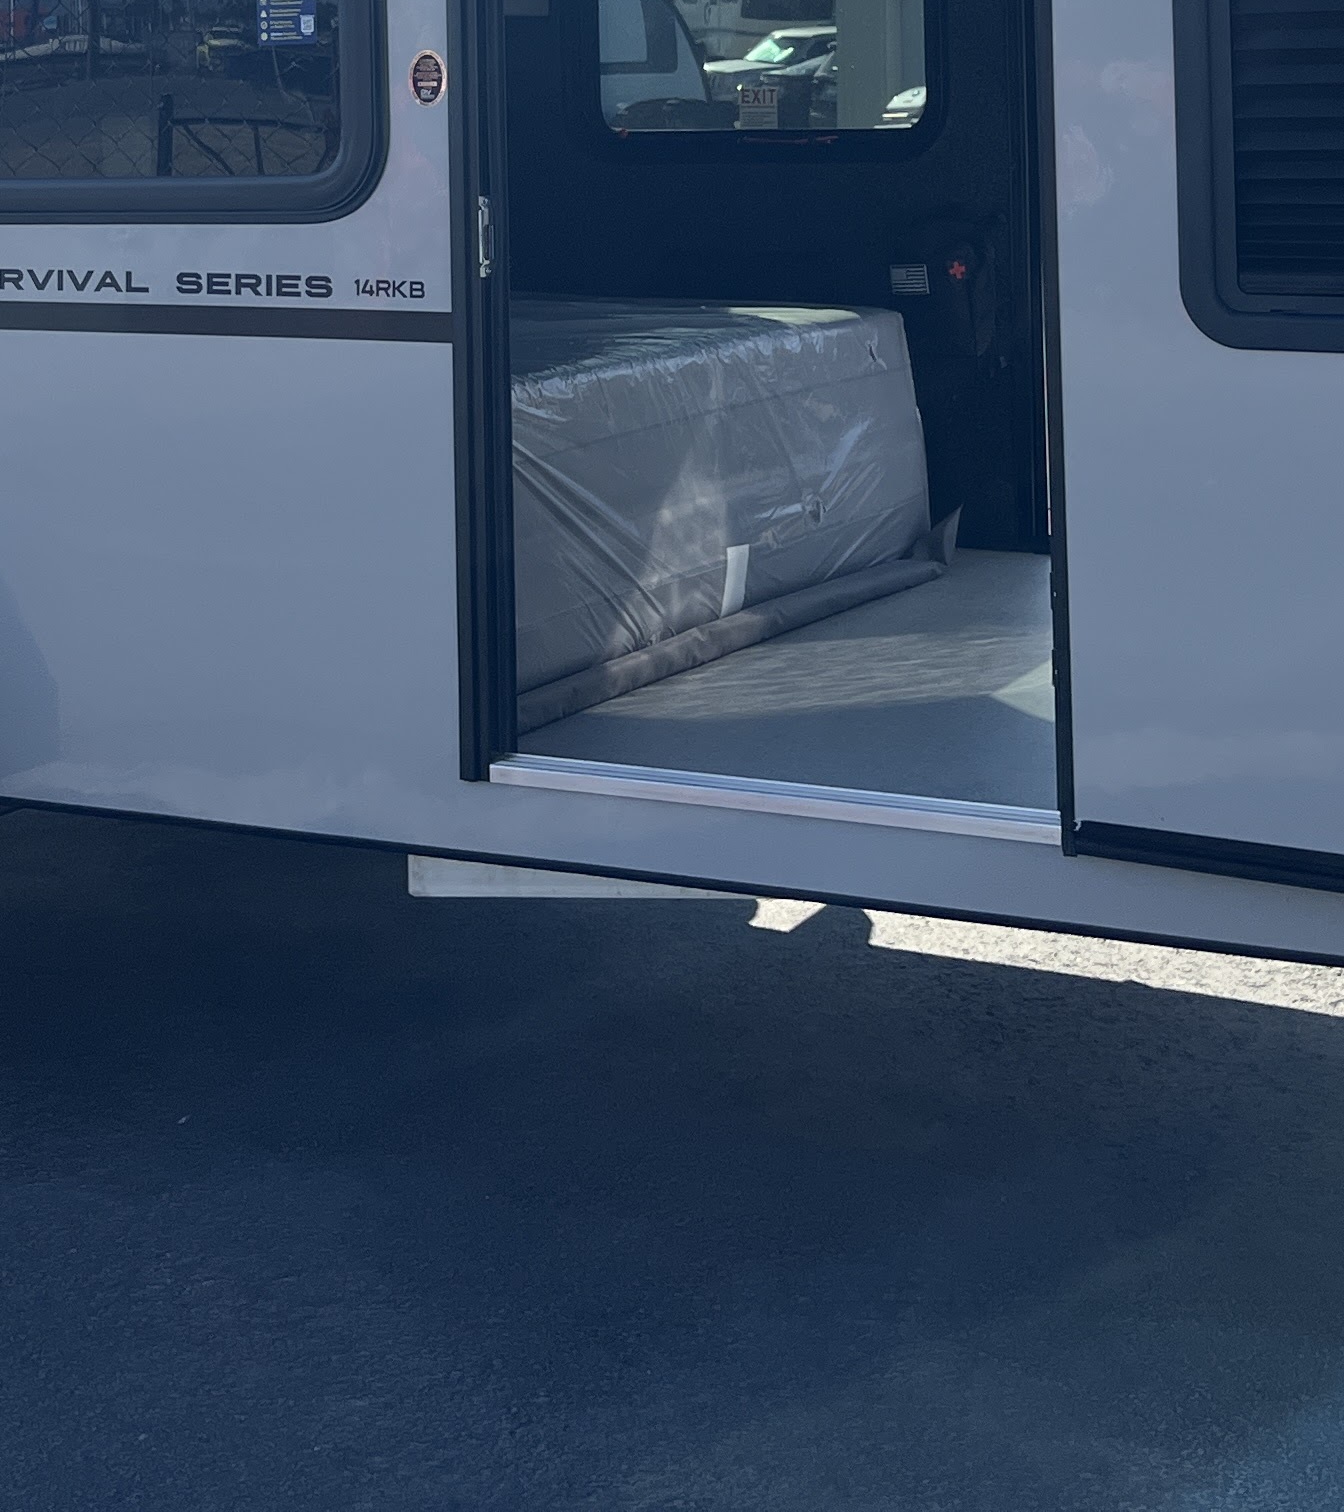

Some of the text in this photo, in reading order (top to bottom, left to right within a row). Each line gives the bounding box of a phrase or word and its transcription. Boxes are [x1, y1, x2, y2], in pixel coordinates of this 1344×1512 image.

[741, 88, 777, 104] EXIT
[175, 272, 333, 298] SERIES
[354, 277, 426, 299] 14RKB
